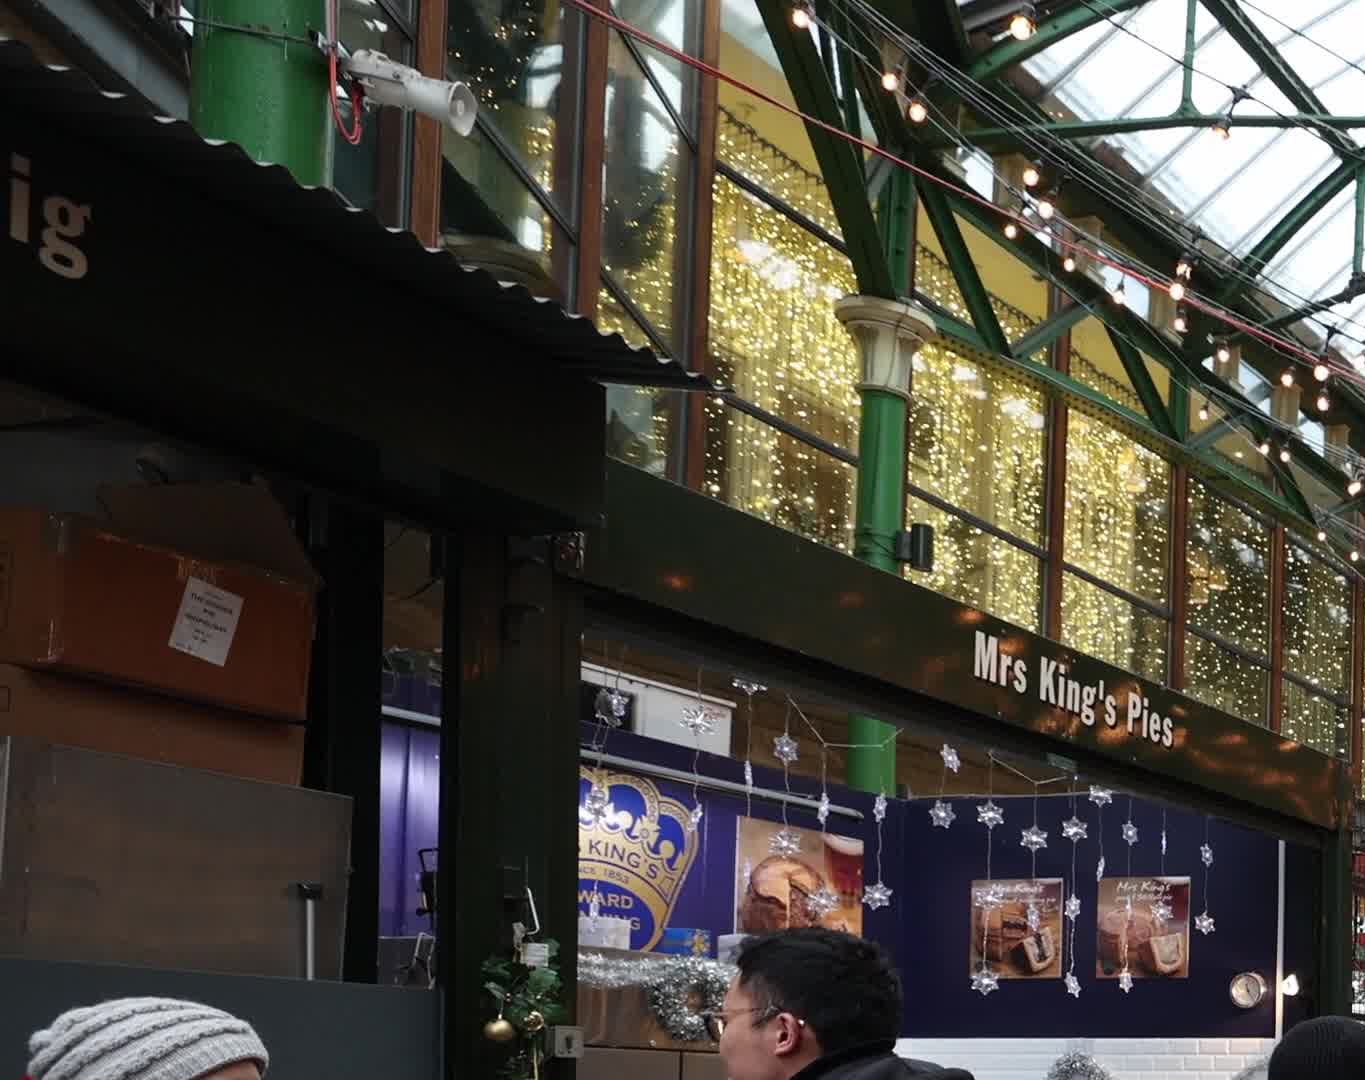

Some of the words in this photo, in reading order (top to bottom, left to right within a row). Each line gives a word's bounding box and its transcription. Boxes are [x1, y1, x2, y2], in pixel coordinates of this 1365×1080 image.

[974, 630, 1028, 694] Mrs
[1039, 656, 1117, 727] King's
[1127, 692, 1173, 748] Pies
[588, 839, 659, 881] KING'S
[1116, 881, 1137, 893] Mrs
[1140, 881, 1172, 894] King's
